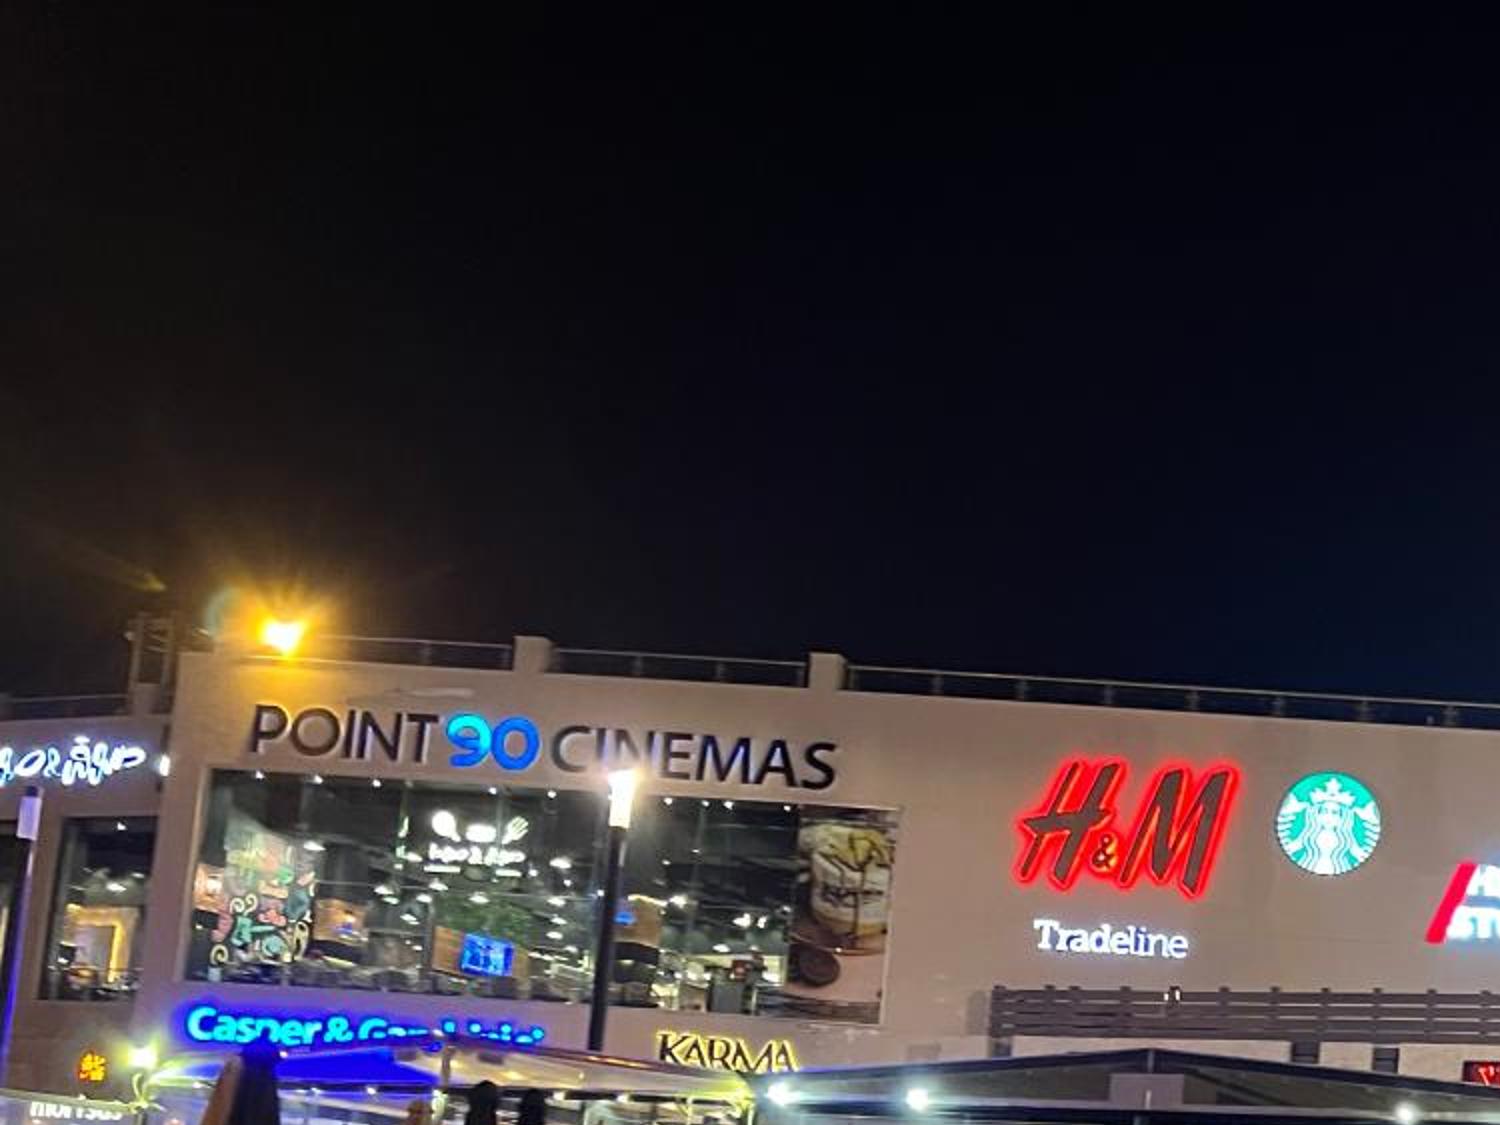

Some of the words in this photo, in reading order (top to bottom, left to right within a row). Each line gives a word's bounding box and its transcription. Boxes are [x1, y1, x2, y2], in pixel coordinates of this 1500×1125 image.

[249, 703, 440, 764] POINT
[446, 712, 542, 772] 90
[551, 724, 839, 790] CINEMAS
[1020, 758, 1236, 900] H&M
[1033, 918, 1189, 958] Tradeline
[323, 1016, 353, 1043] &
[656, 1030, 799, 1074] KARMA
